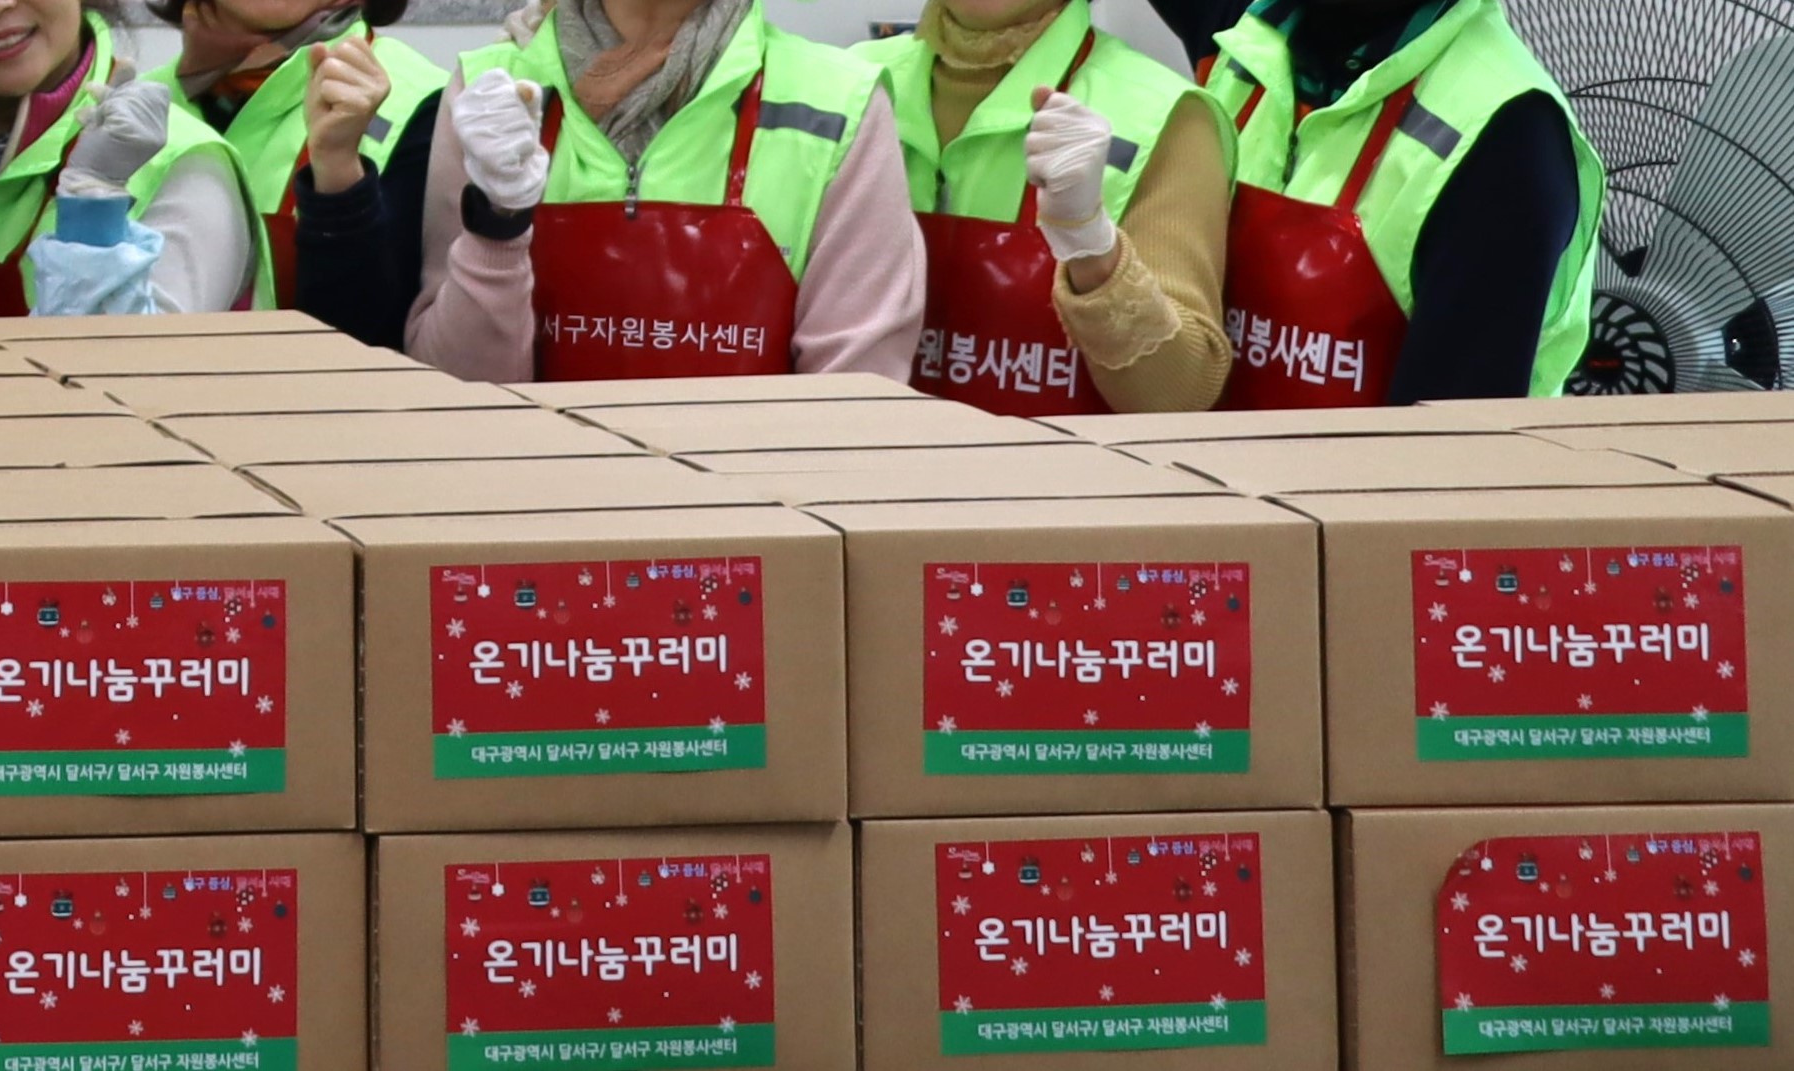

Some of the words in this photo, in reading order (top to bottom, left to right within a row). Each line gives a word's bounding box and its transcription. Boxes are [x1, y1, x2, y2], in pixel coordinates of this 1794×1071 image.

[918, 328, 1079, 398] 원봉사센터
[469, 634, 727, 687] 온기나눔꾸러미
[960, 639, 1215, 686] 온기나눔꾸러미
[1451, 622, 1709, 672] 온기나눔꾸러미
[471, 744, 542, 764] 대구광역시
[546, 742, 594, 761] 달서구/
[598, 741, 640, 760] 달서구
[644, 738, 728, 758] 자원봉사센터
[961, 743, 1030, 761] 대구광역시
[1035, 743, 1081, 760] 달서구/
[1086, 742, 1126, 760] 달서구
[1131, 742, 1213, 760] 자원봉사센터
[1454, 728, 1524, 746] 대구광역시
[1529, 727, 1576, 746] 달서구/
[1581, 727, 1622, 745] 달서구
[1627, 726, 1711, 745] 자원봉사센터
[66, 763, 113, 781] 달서구/
[118, 762, 159, 781] 달서구
[164, 762, 248, 780] 자원봉사센터
[974, 910, 1227, 964] 온기나눔꾸러미
[1473, 910, 1730, 961] 온기나눔꾸러미
[4, 947, 261, 997] 온기나눔꾸러미
[483, 933, 737, 986] 온기나눔꾸러미
[978, 1020, 1047, 1041] 대구광역시
[1052, 1019, 1098, 1038] 달서구/
[1102, 1017, 1143, 1036] 달서구
[1147, 1014, 1230, 1035] 자원봉사센터
[1478, 1019, 1549, 1038] 대구광역시
[1553, 1018, 1600, 1037] 달서구/
[1604, 1017, 1646, 1036] 달서구
[1650, 1015, 1733, 1035] 자원봉사센터
[4, 1055, 75, 1071] 대구광역시
[131, 1053, 172, 1071] 달서구
[176, 1051, 260, 1071] 자원봉사센터
[485, 1043, 554, 1063] 대구광역시
[559, 1041, 605, 1060] 달서구/
[610, 1040, 650, 1059] 달서구
[655, 1037, 738, 1057] 자원봉사센터
